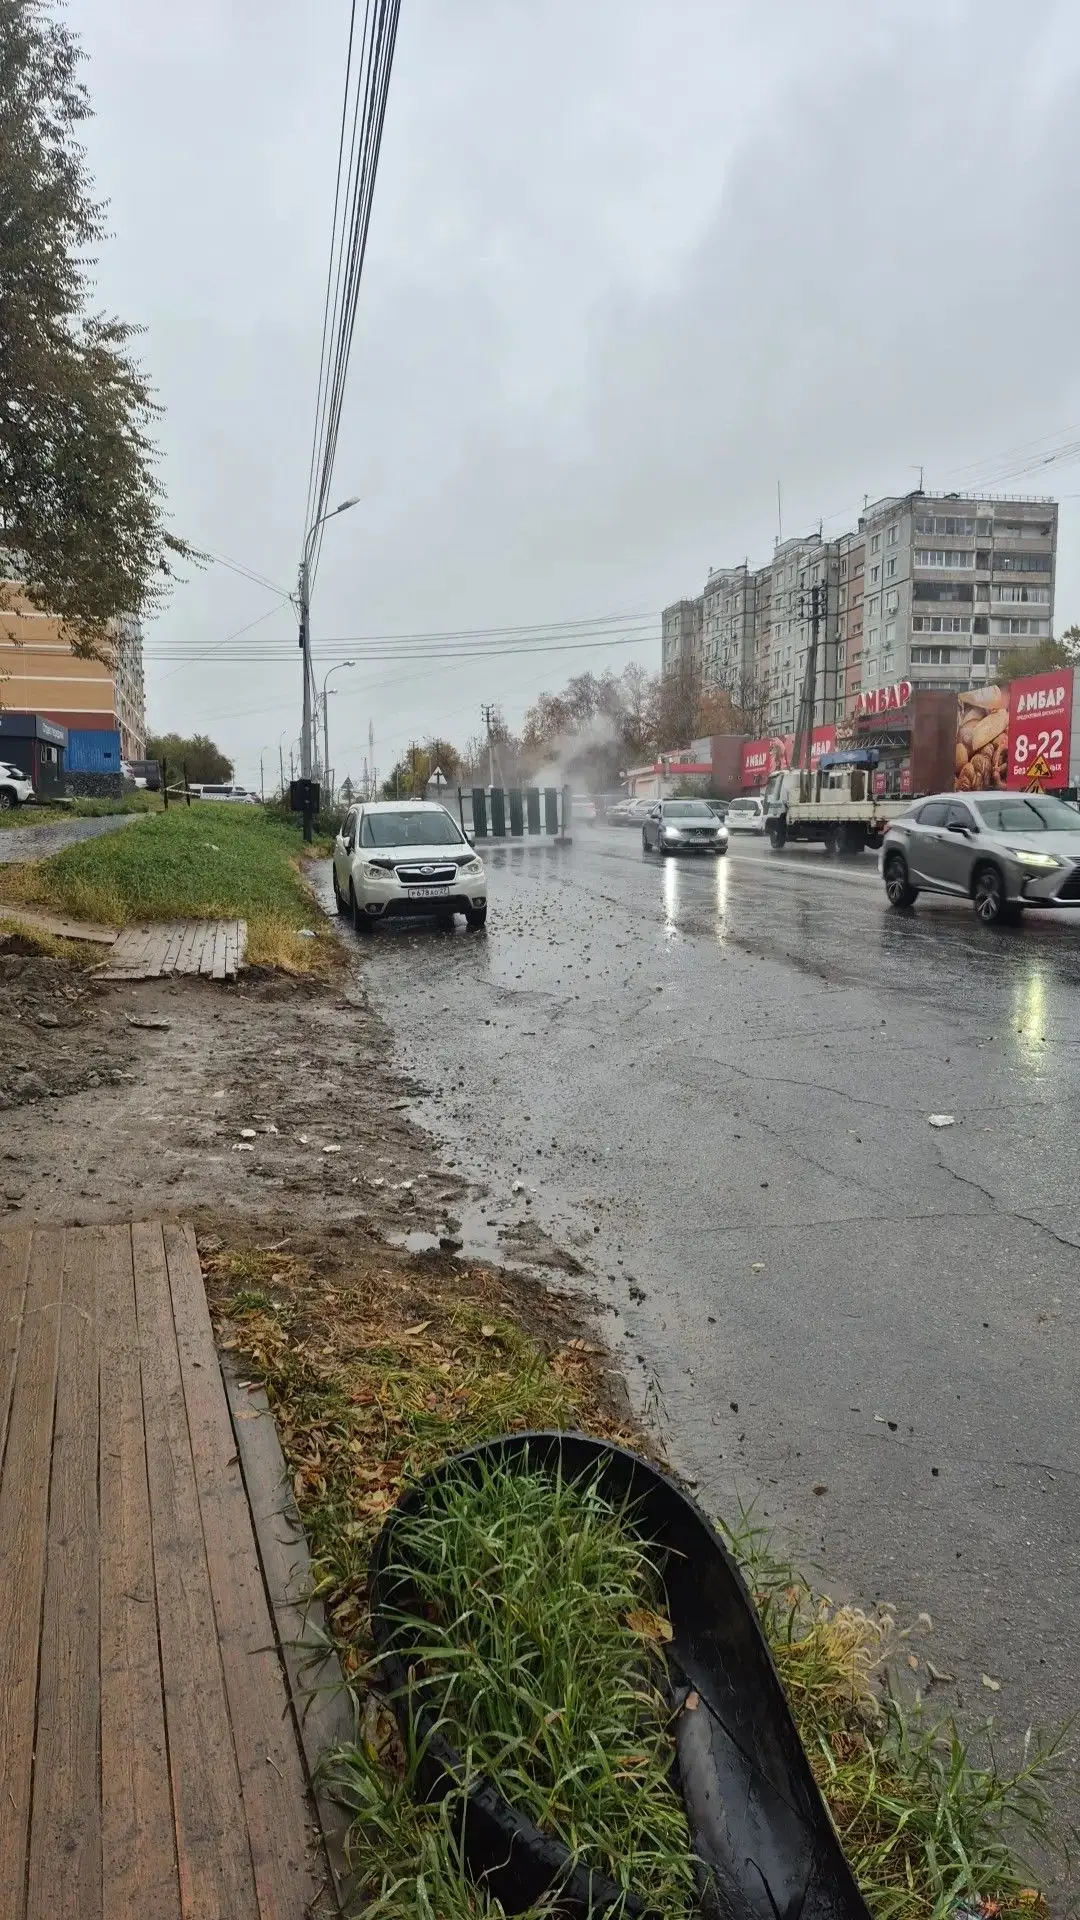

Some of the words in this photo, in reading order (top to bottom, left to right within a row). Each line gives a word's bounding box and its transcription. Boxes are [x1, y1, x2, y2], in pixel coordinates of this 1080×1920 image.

[856, 681, 912, 715] АМБАР
[1016, 686, 1065, 713] АМБАР
[805, 740, 831, 759] МБАР
[1015, 729, 1063, 762] 8-22
[746, 753, 767, 768] АМБАР
[1013, 765, 1026, 775] Без
